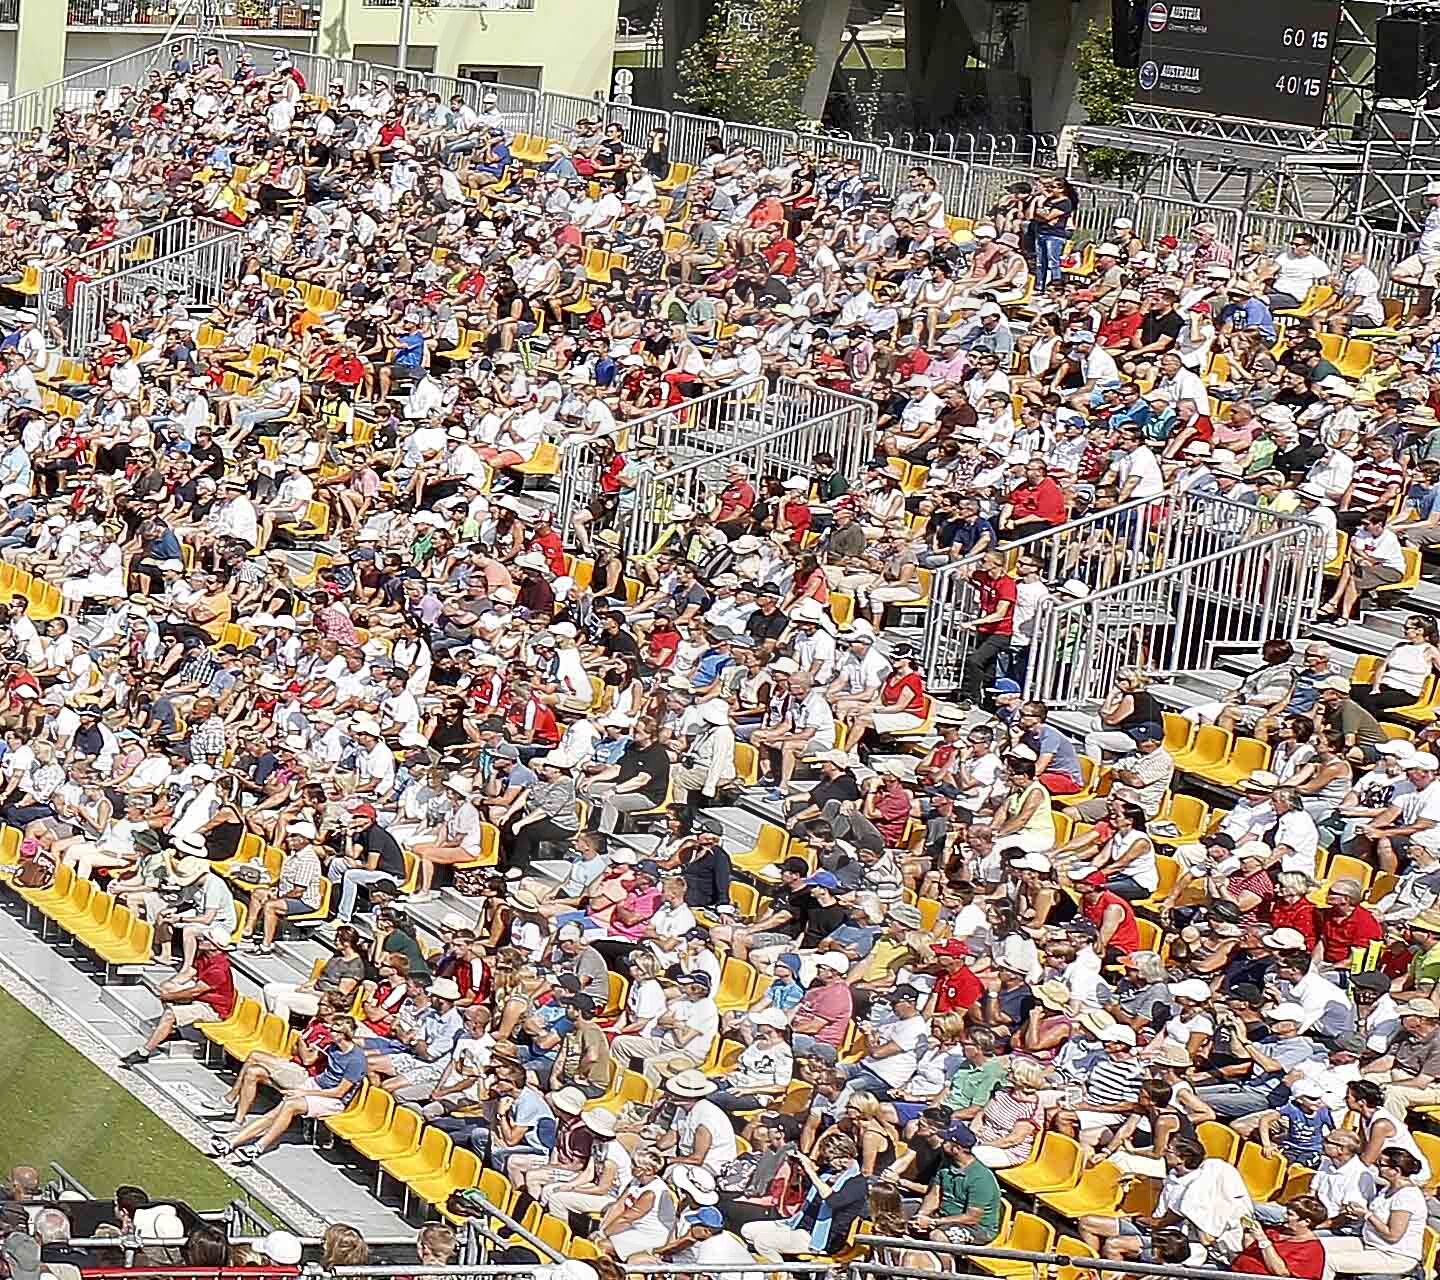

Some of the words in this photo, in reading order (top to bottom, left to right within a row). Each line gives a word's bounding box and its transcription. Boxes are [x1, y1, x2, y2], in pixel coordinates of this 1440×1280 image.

[1169, 5, 1201, 21] AUSTRIA
[1311, 31, 1329, 49] 15
[1160, 64, 1200, 81] AUSTRALIA
[1303, 78, 1321, 97] 15
